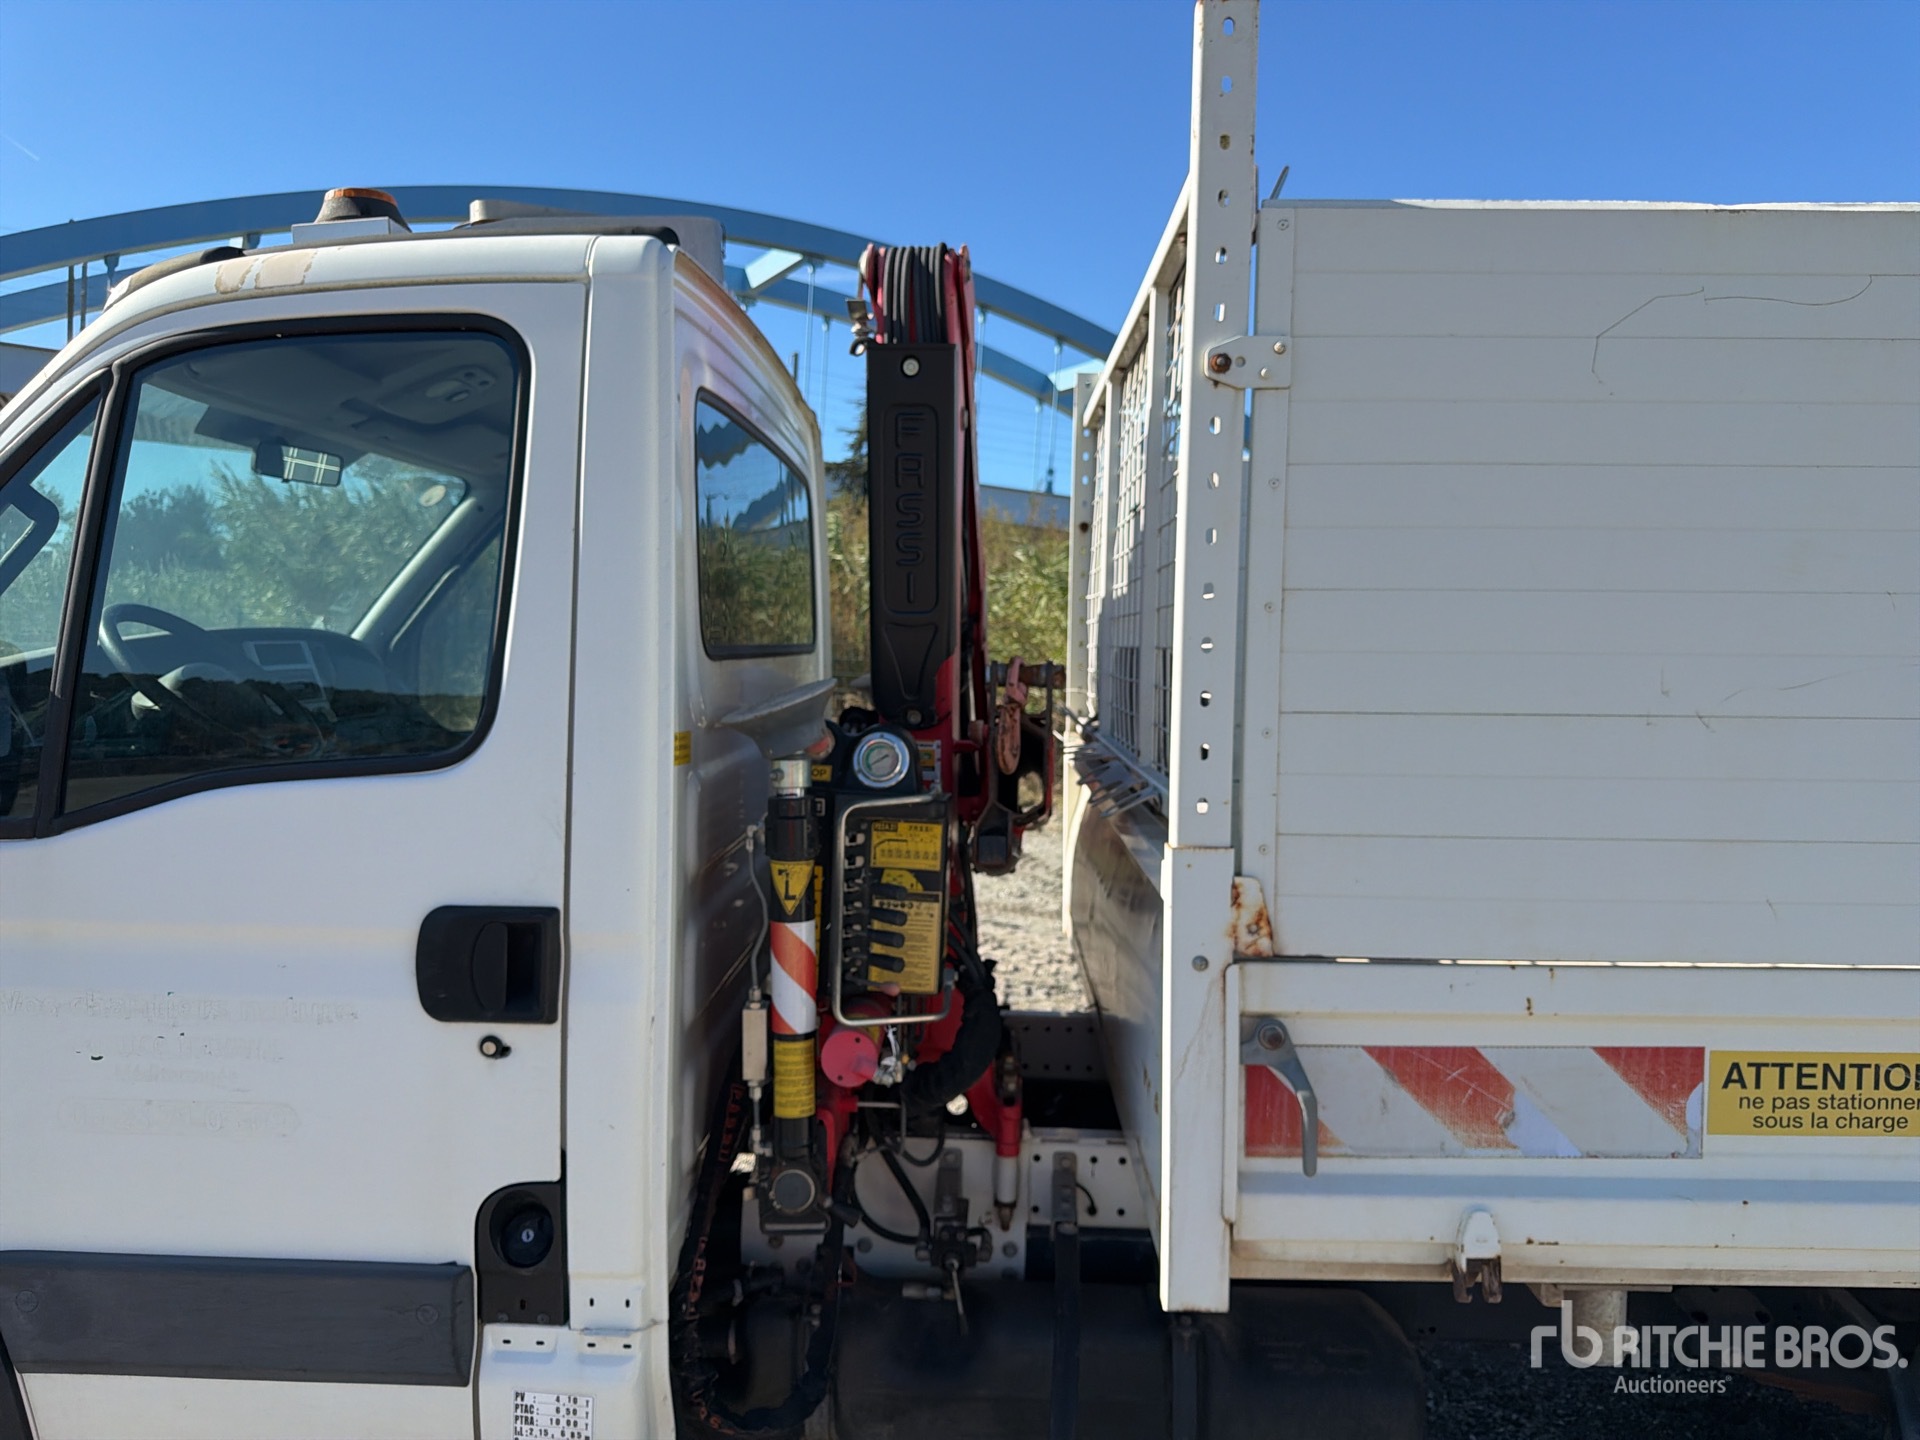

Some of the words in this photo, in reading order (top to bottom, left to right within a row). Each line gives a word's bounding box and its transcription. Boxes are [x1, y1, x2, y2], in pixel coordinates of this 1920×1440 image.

[894, 411, 925, 604] FASSI
[1721, 1061, 1920, 1091] ATTENTIO
[1738, 1095, 1765, 1110] ne
[1772, 1095, 1811, 1113] pas
[1752, 1115, 1804, 1129] sous
[1811, 1112, 1829, 1129] la
[1835, 1112, 1909, 1133] charge
[515, 1392, 525, 1402] PV
